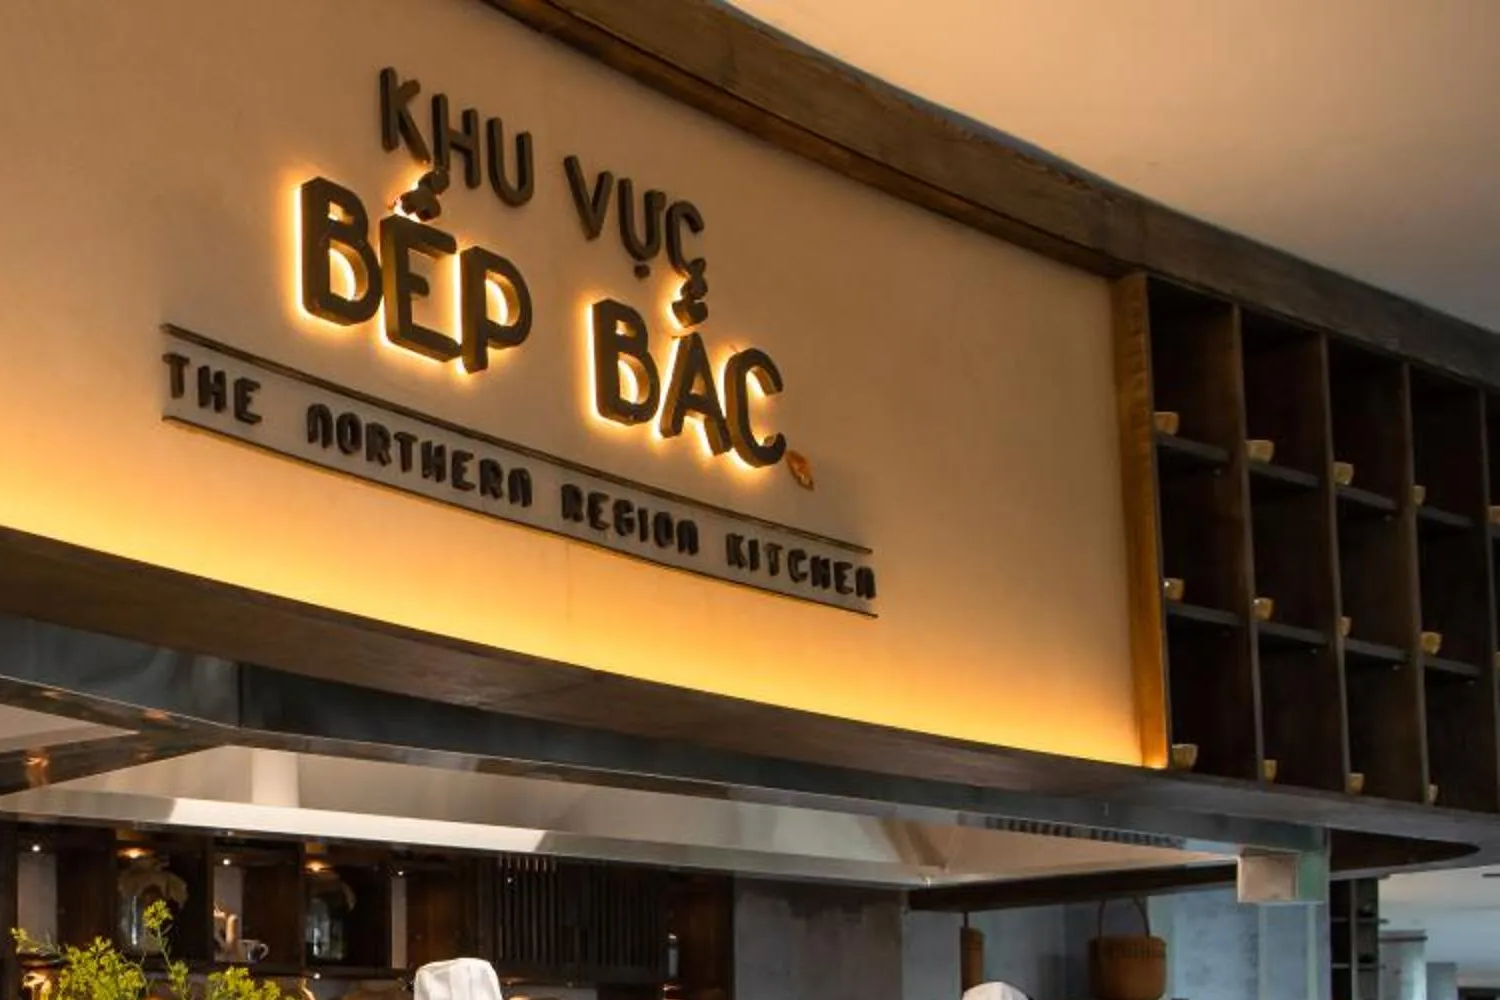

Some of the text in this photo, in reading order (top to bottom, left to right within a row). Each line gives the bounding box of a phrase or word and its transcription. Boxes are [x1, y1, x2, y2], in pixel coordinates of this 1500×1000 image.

[380, 66, 705, 279] KHU VỰC
[301, 168, 787, 468] BẾP BẮC
[162, 353, 877, 599] THE NORTHERN REGION KITCHEN
